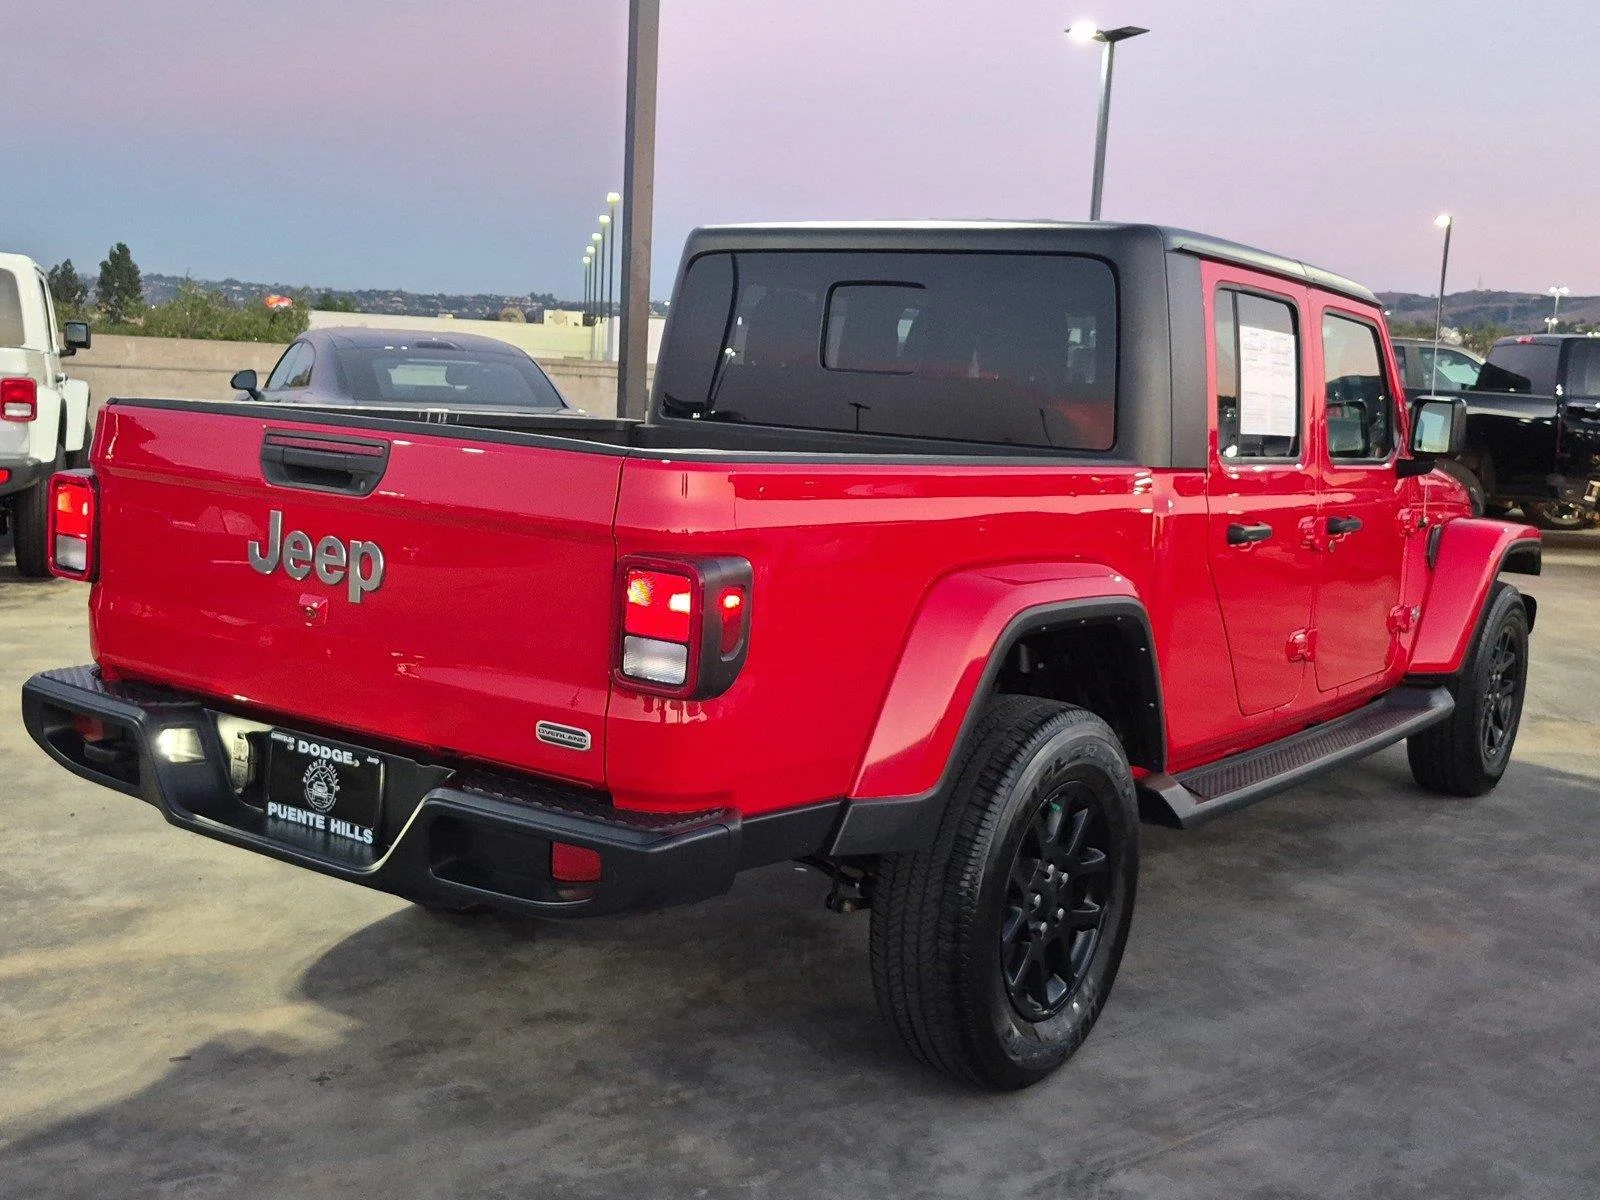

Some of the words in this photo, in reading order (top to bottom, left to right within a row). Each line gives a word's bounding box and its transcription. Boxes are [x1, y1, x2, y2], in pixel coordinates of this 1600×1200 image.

[248, 510, 384, 603] Jeep
[298, 739, 353, 765] DODGE
[538, 728, 587, 743] OVERLAND
[267, 801, 326, 830] PUENTE
[330, 819, 374, 845] HILLS
